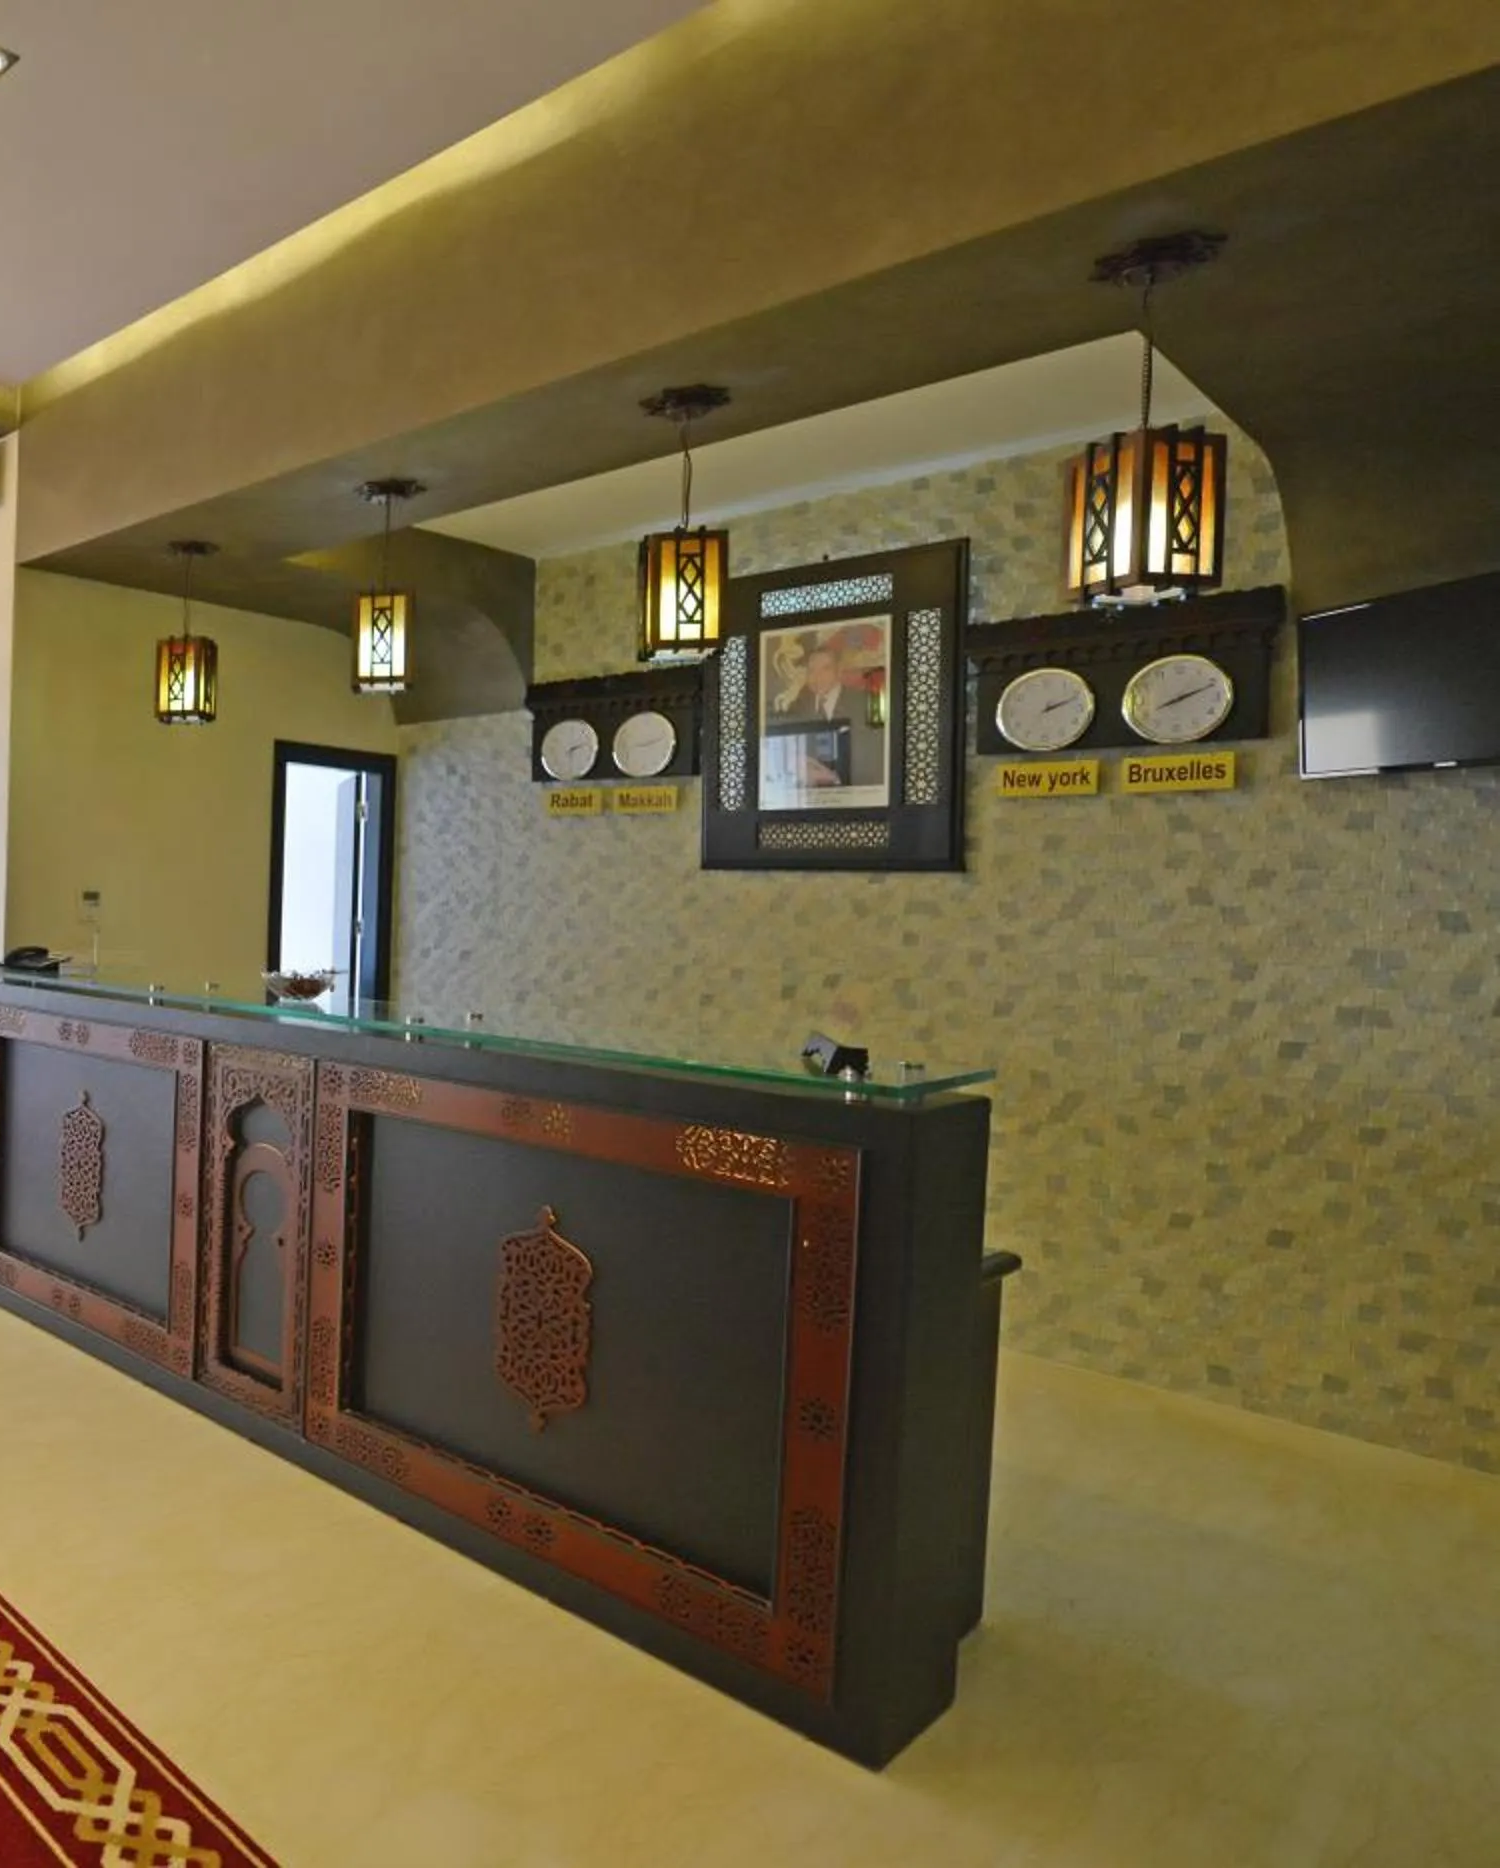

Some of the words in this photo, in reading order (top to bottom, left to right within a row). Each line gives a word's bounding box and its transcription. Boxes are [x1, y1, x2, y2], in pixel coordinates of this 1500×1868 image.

[1002, 769, 1042, 788] New
[1048, 768, 1091, 790] york
[1128, 760, 1227, 784] Bruxelles
[550, 792, 594, 808] Rabat
